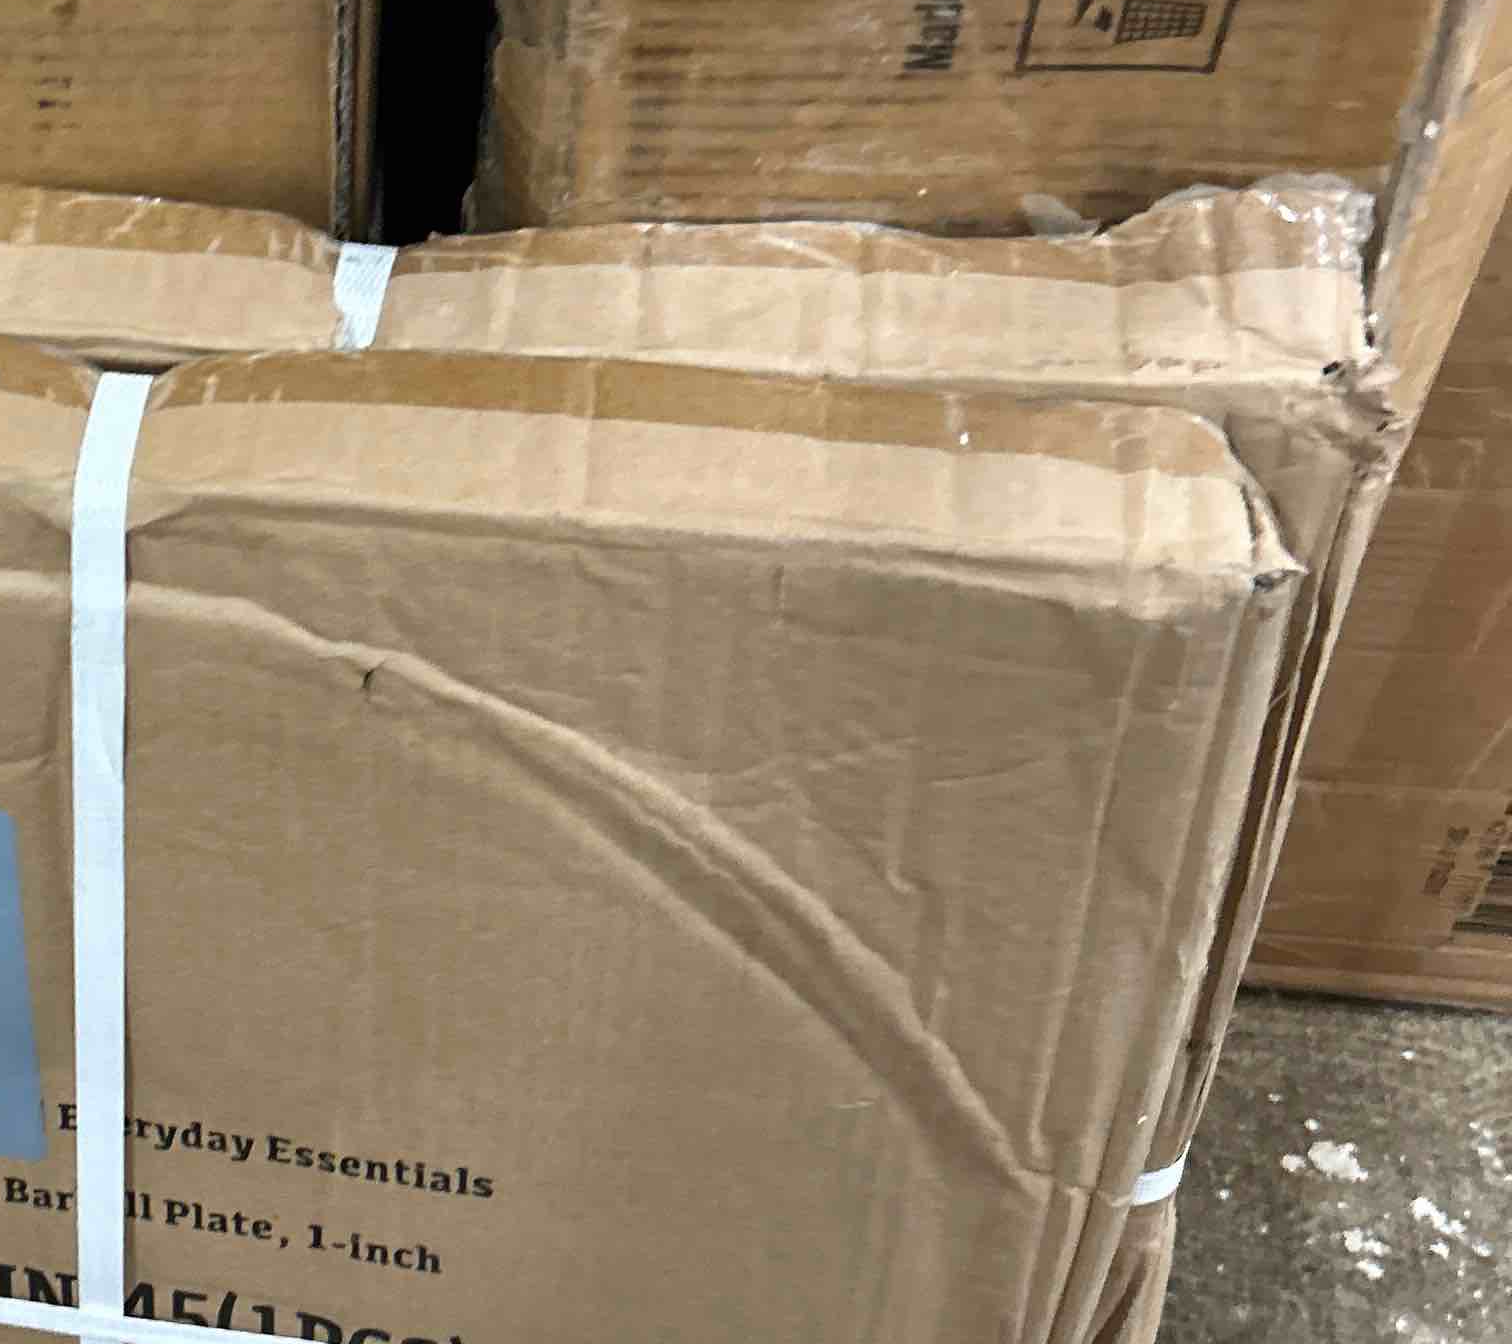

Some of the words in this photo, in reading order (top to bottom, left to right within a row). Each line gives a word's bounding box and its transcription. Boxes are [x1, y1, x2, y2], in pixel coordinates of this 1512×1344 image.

[58, 1103, 255, 1162] Eryday
[266, 1135, 495, 1199] Essentials
[4, 1175, 153, 1222] Barll
[164, 1198, 290, 1249] Plate,
[307, 1223, 442, 1274] 1-inch
